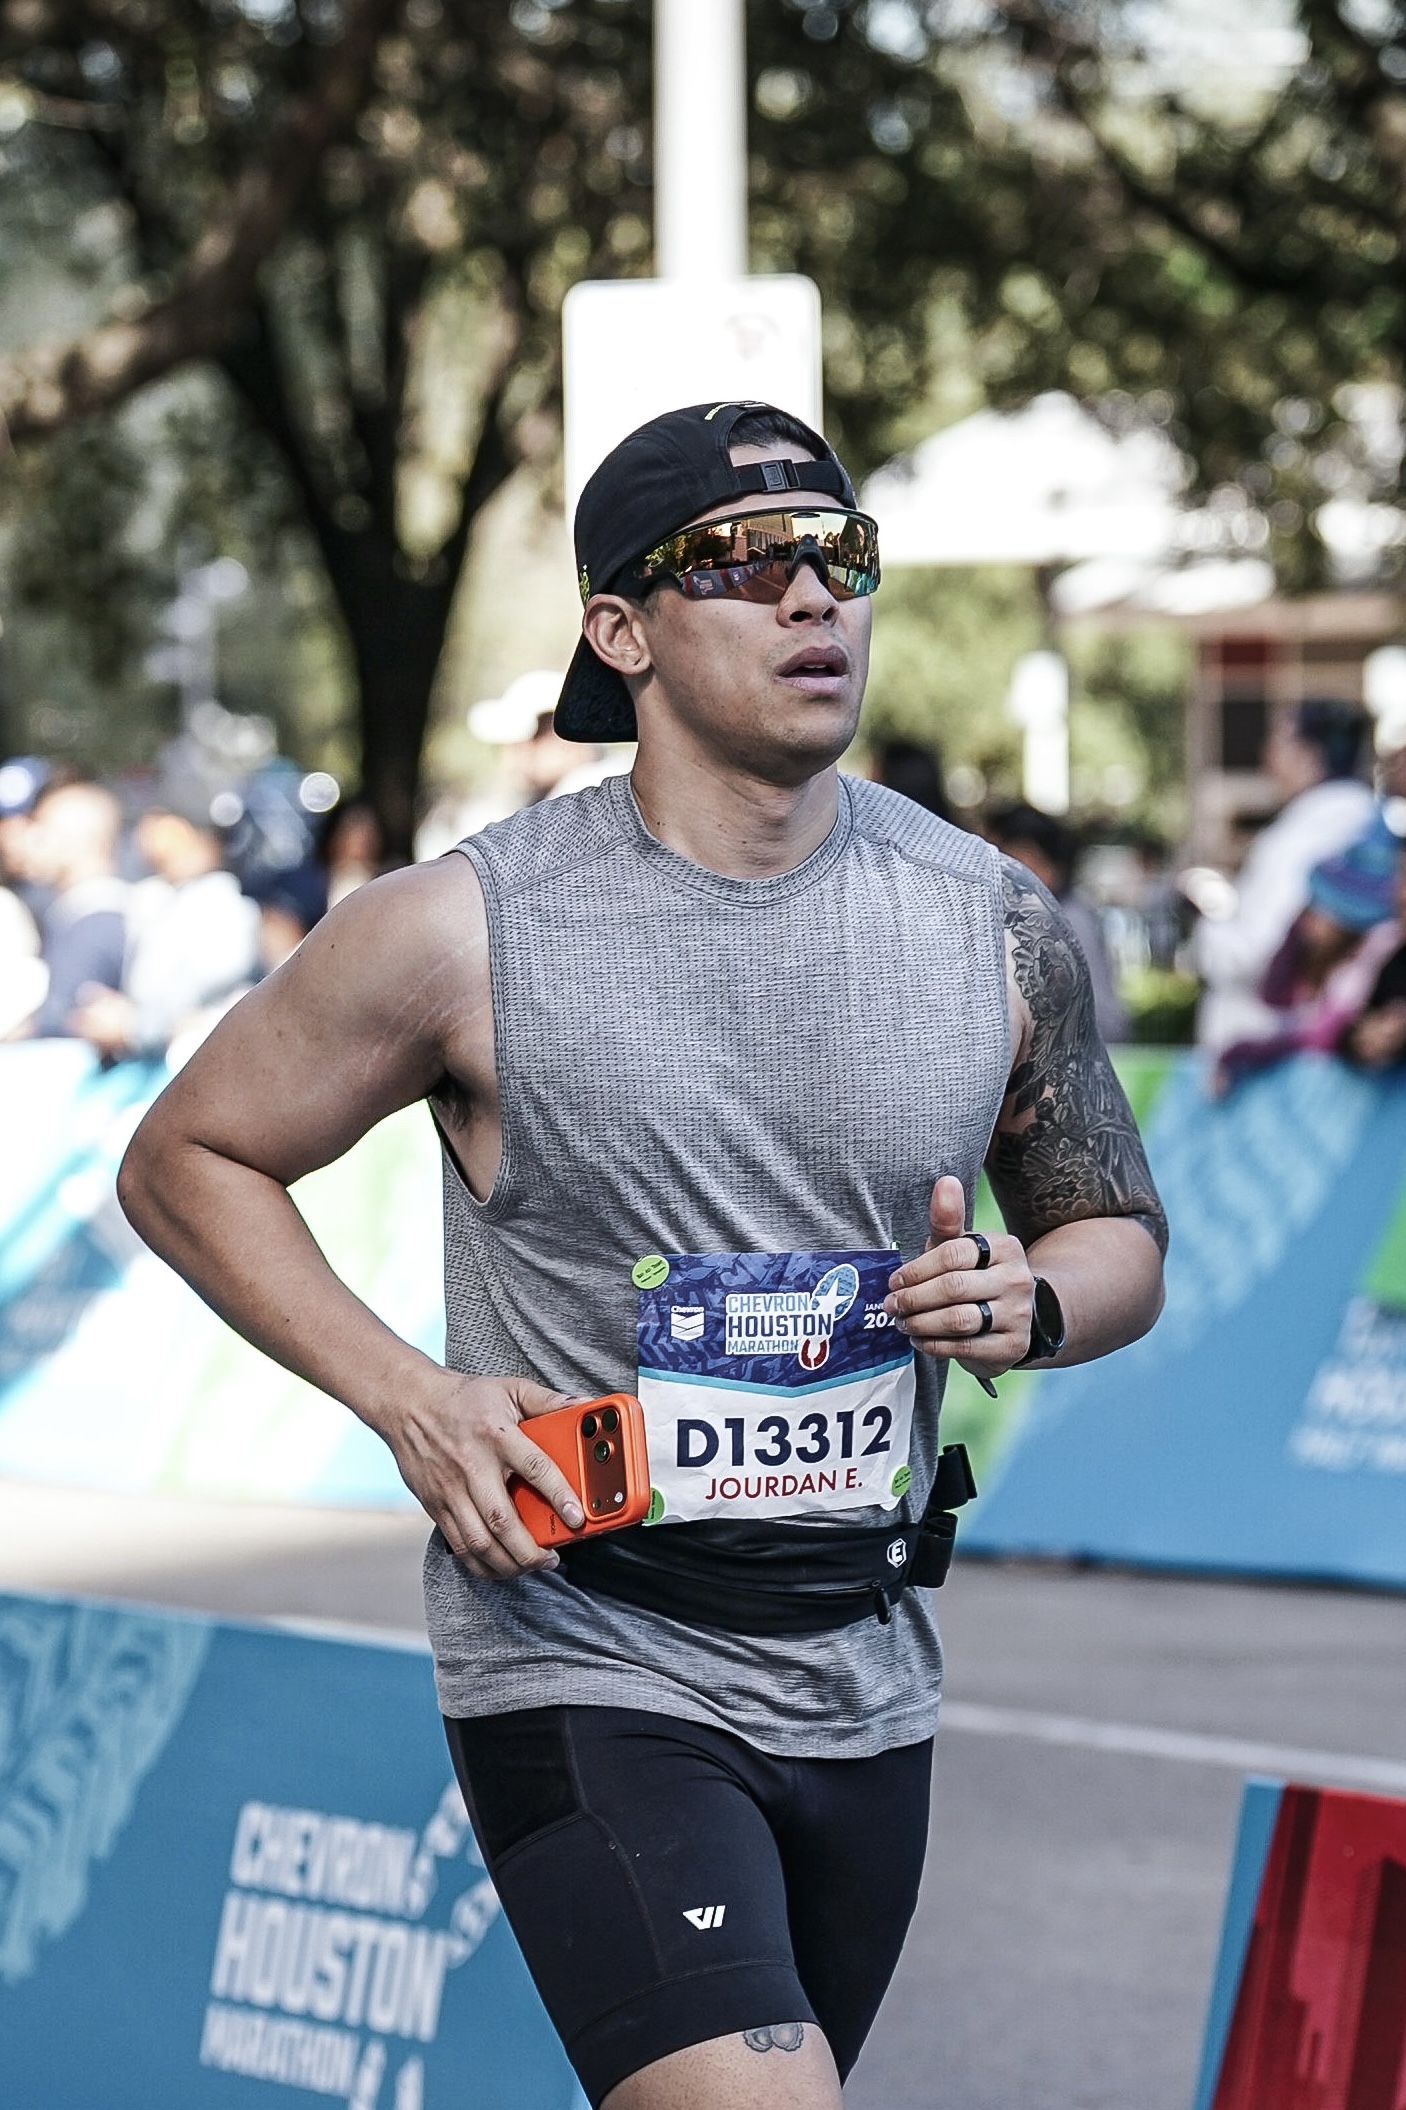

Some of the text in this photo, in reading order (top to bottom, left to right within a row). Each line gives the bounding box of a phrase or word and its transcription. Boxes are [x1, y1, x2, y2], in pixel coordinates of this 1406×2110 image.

[728, 1294, 809, 1314] CHEVRON
[728, 1313, 832, 1338] HOUSTON
[727, 1338, 800, 1354] MARATHON
[676, 1405, 893, 1468] D13312
[705, 1469, 837, 1501] JOURDAN
[845, 1467, 863, 1490] E.
[230, 1800, 417, 1917] CHEVRON
[211, 1888, 447, 2044] HOUSTON
